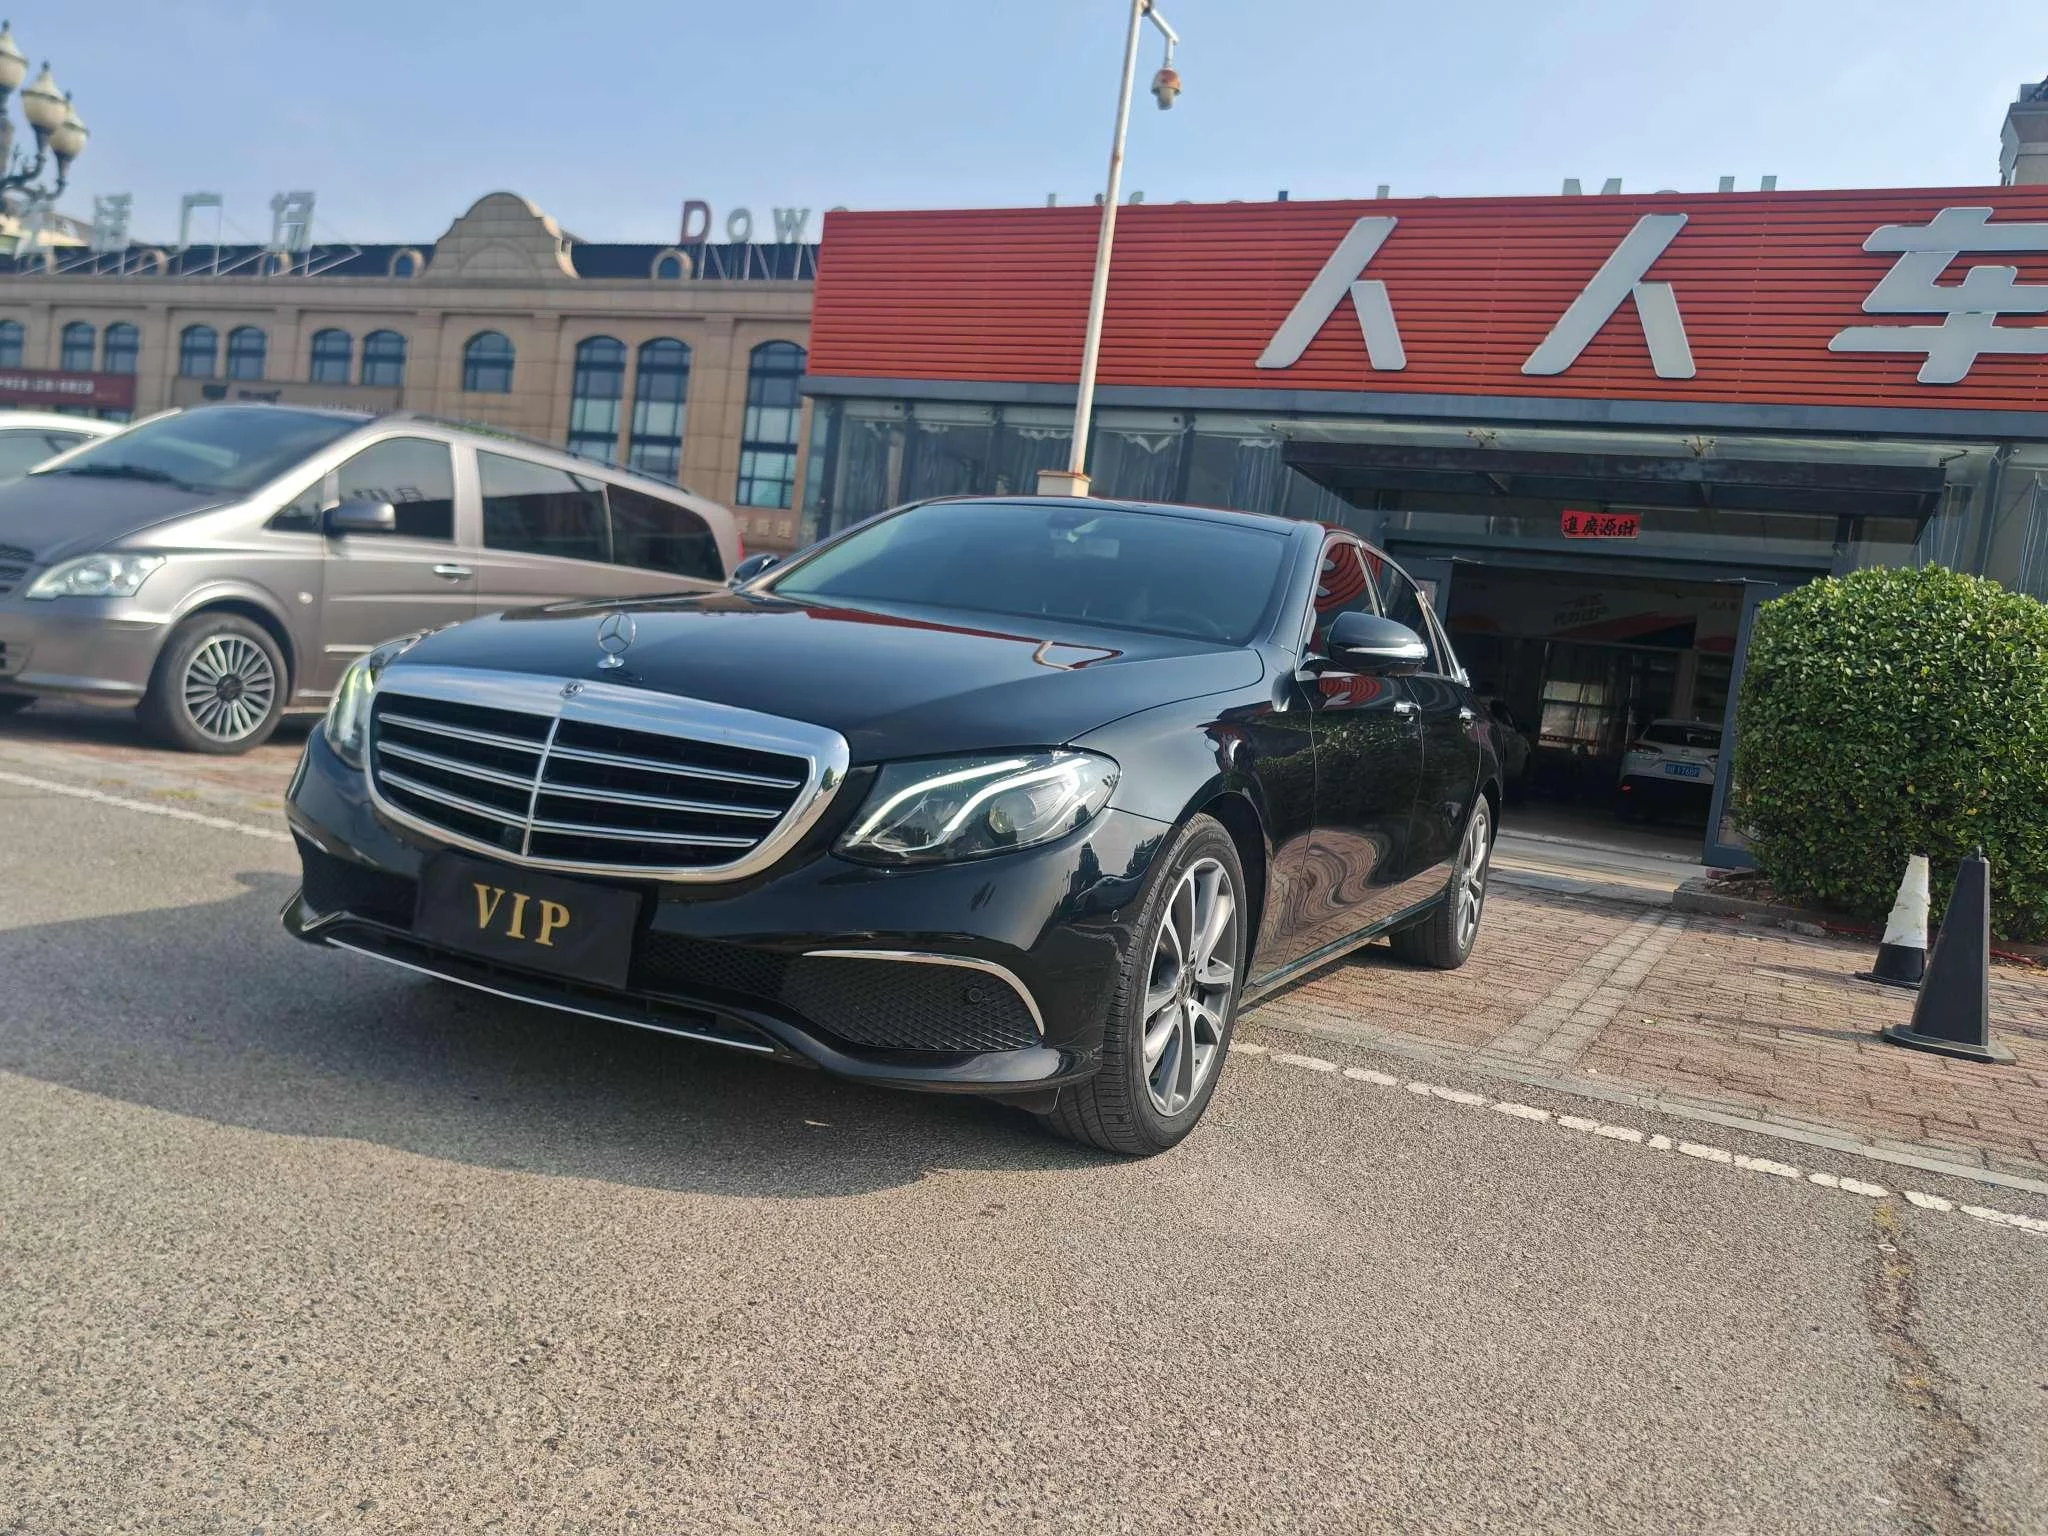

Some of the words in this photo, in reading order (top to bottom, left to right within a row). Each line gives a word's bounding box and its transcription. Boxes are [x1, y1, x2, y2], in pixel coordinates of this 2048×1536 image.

[681, 201, 848, 245] Dow
[1255, 206, 2048, 384] 人人车
[473, 883, 570, 946] VIP
